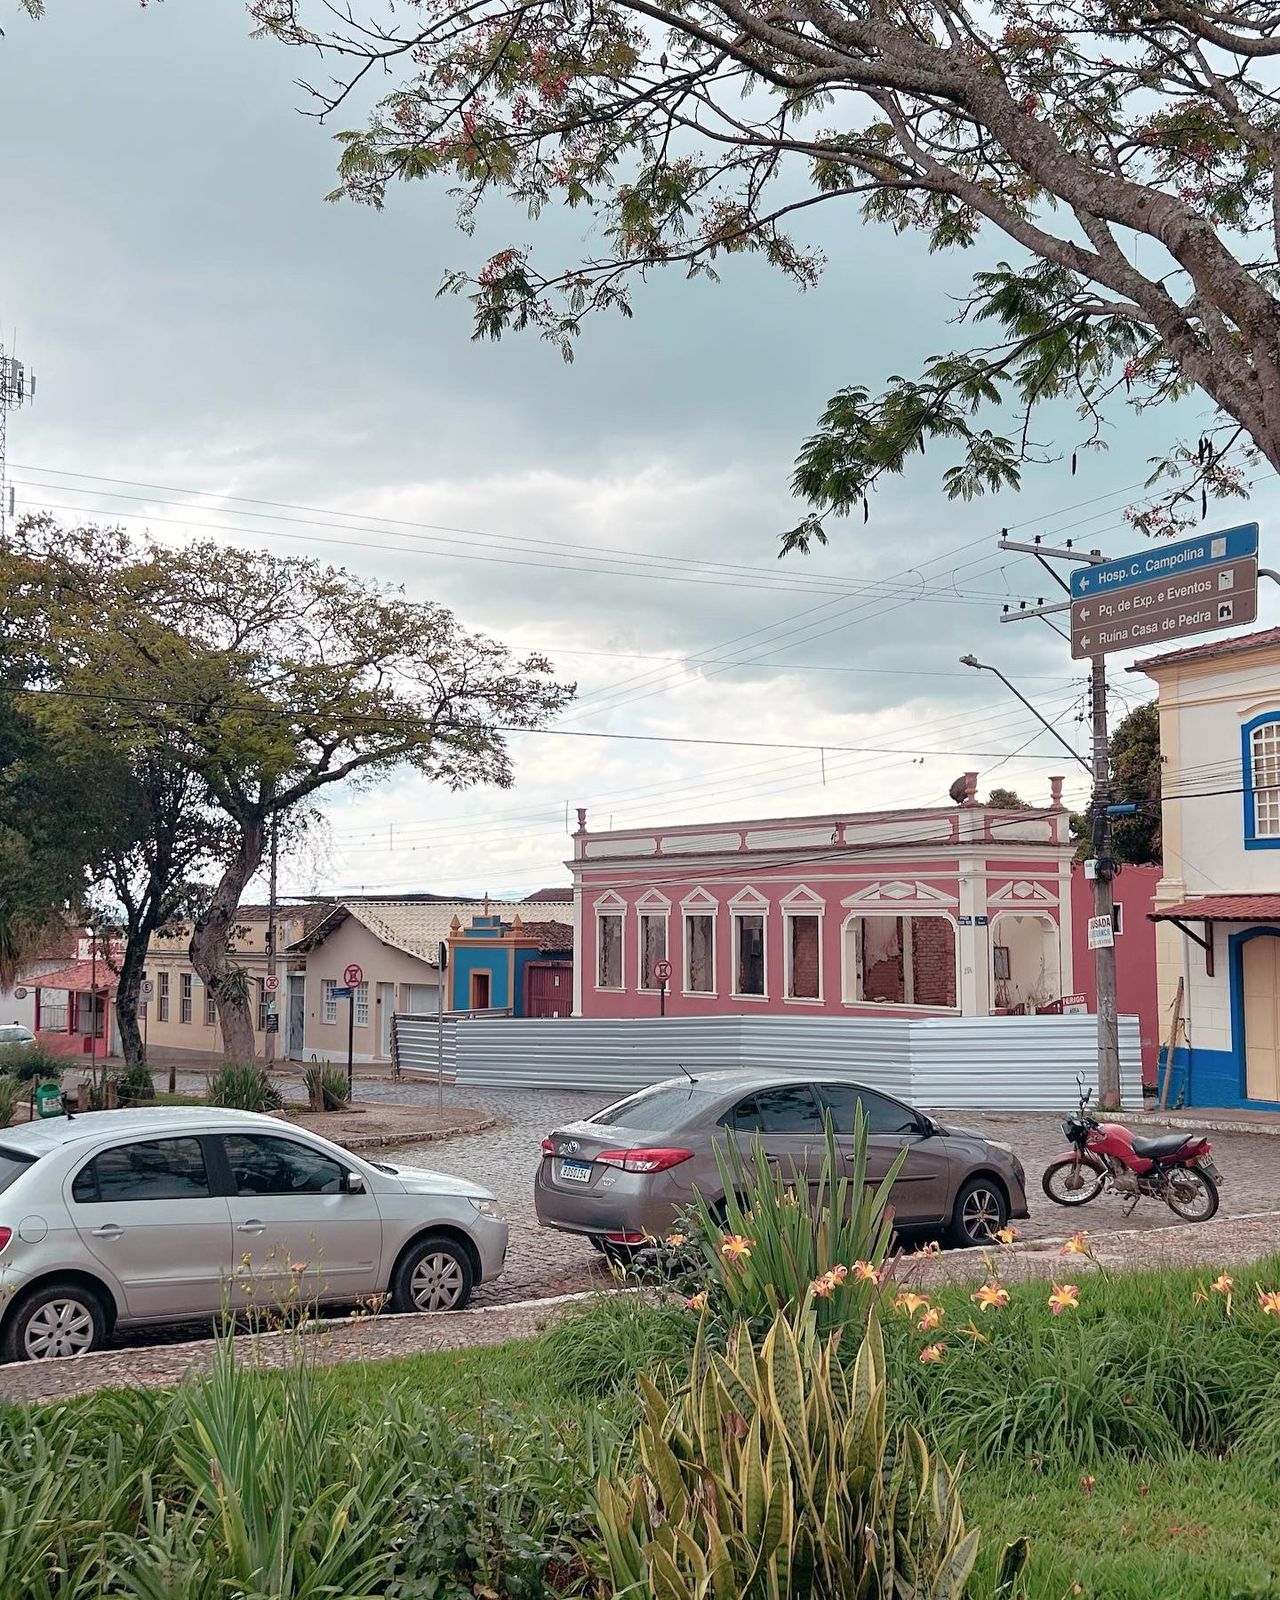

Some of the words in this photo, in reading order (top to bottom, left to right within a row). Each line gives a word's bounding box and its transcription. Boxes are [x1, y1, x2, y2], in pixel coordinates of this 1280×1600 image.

[1098, 569, 1128, 584] Hosp.
[1130, 563, 1142, 576] C.
[1146, 547, 1204, 572] Campolina
[1099, 604, 1115, 617] Pq.
[1118, 600, 1131, 612] de
[1133, 594, 1155, 608] Exp.
[1157, 593, 1165, 602] e
[1167, 580, 1211, 600] Eventos
[1099, 628, 1129, 645] Ruína
[1131, 622, 1158, 637] Casa
[1161, 617, 1176, 630] de
[1178, 610, 1211, 627] Pedra
[1062, 996, 1085, 1005] PERIGO
